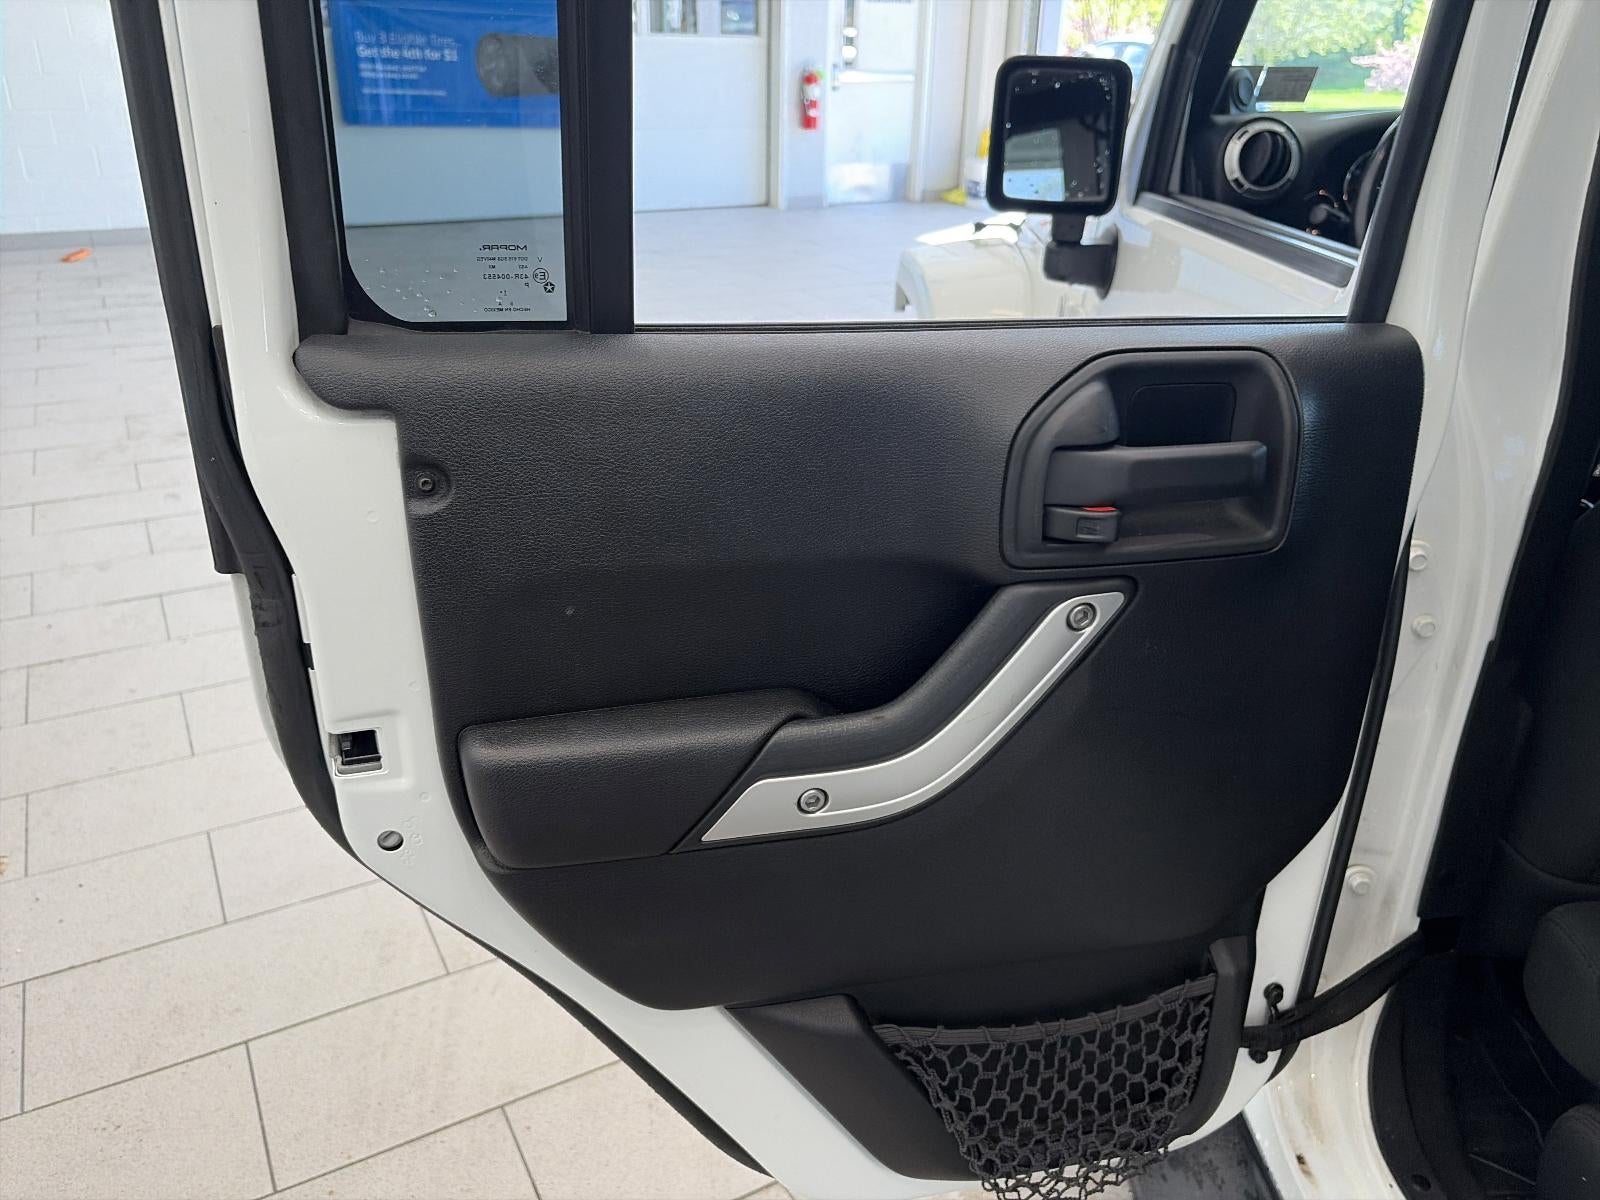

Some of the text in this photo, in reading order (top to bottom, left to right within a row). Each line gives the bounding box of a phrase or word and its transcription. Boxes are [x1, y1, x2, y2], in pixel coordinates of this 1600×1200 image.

[356, 45, 379, 58] Get
[380, 47, 400, 59] the
[401, 48, 423, 60] 4th
[424, 49, 442, 61] for
